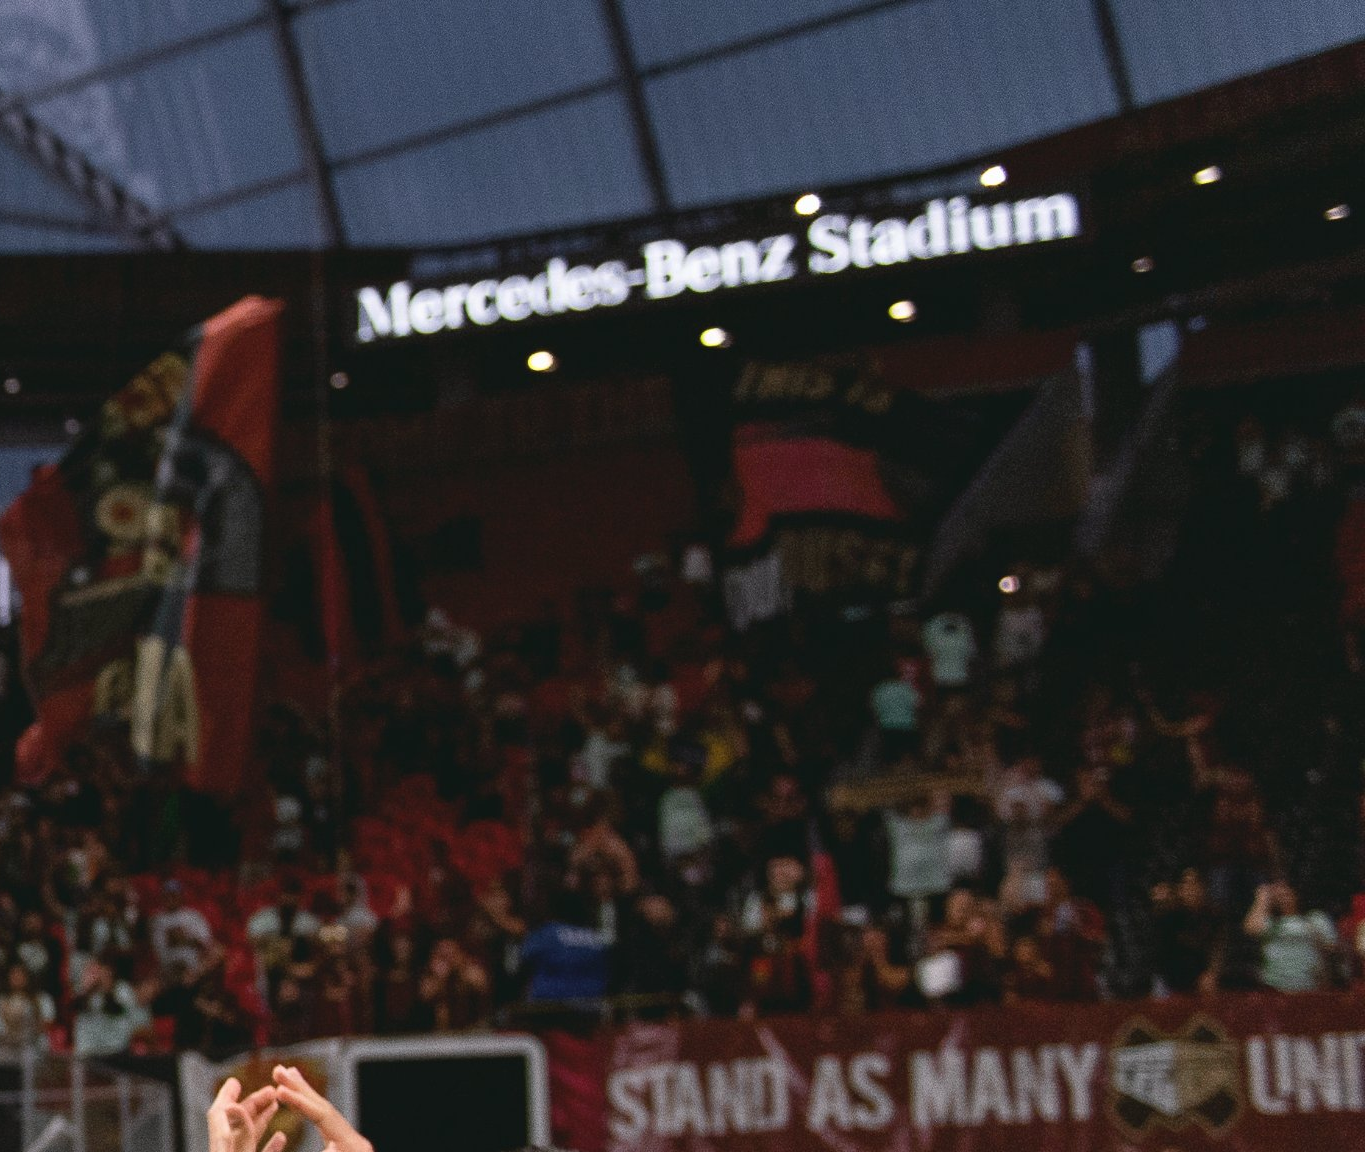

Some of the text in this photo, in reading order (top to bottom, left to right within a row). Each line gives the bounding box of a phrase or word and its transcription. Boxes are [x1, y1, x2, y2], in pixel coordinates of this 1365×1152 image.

[355, 192, 1080, 342] Mercedes-Benz Stadium
[606, 1056, 790, 1140] STAND
[807, 1051, 895, 1131] AS
[909, 1042, 1100, 1130] MANY
[1247, 1031, 1365, 1115] UNI
